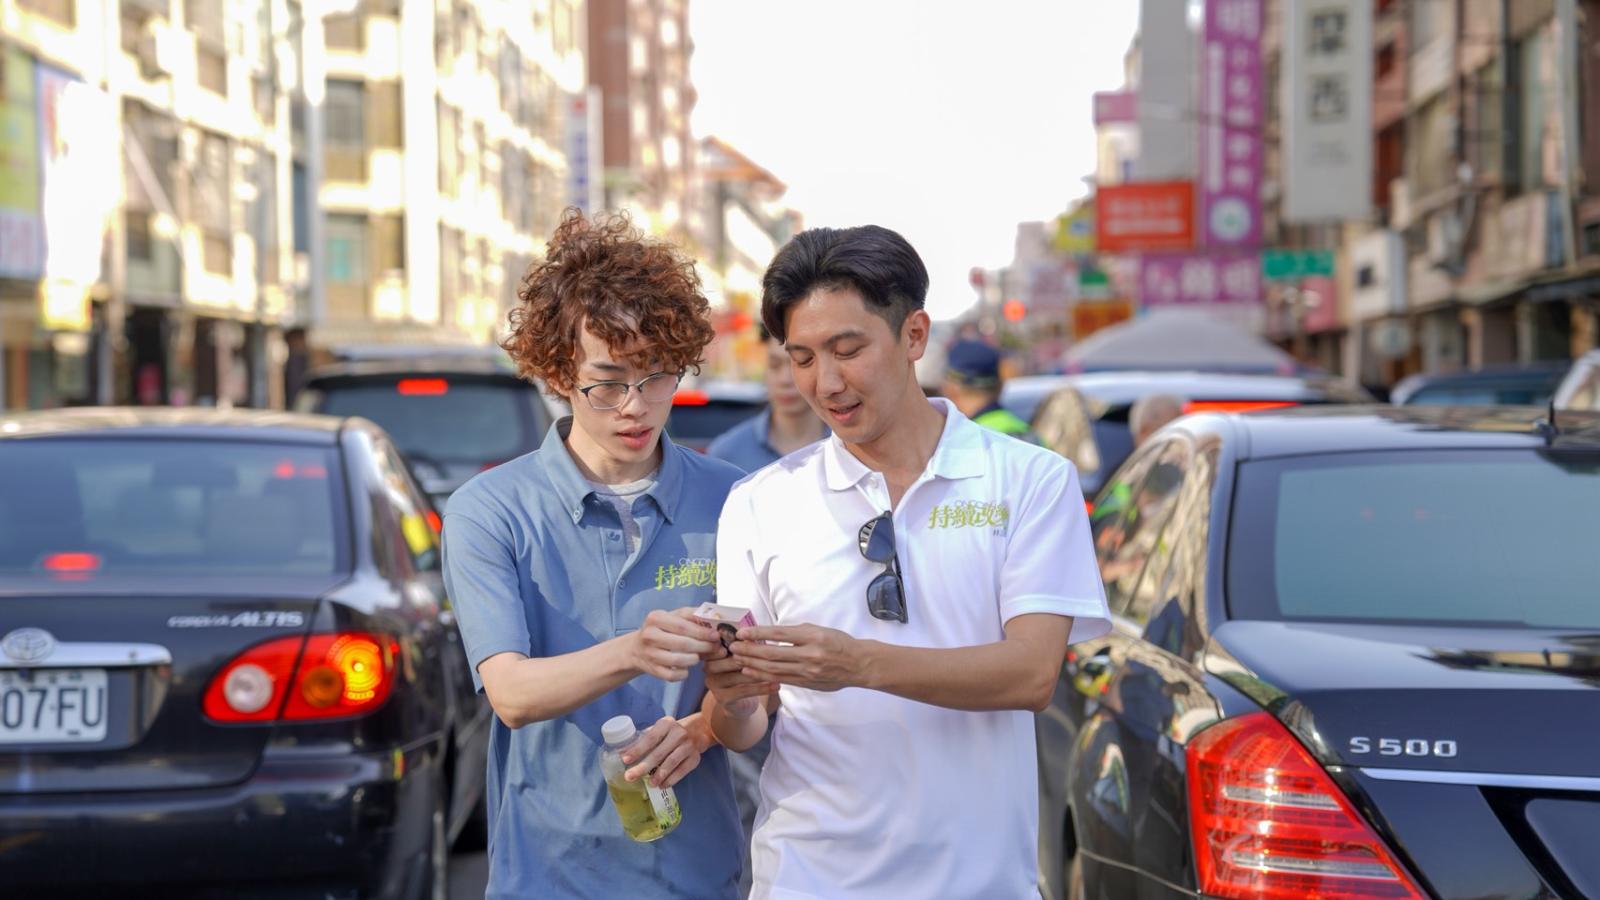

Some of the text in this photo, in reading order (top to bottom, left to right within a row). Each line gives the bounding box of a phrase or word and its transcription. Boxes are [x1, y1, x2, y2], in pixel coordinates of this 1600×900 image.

[230, 611, 303, 627] ALTIS
[1349, 736, 1457, 758] S 500
